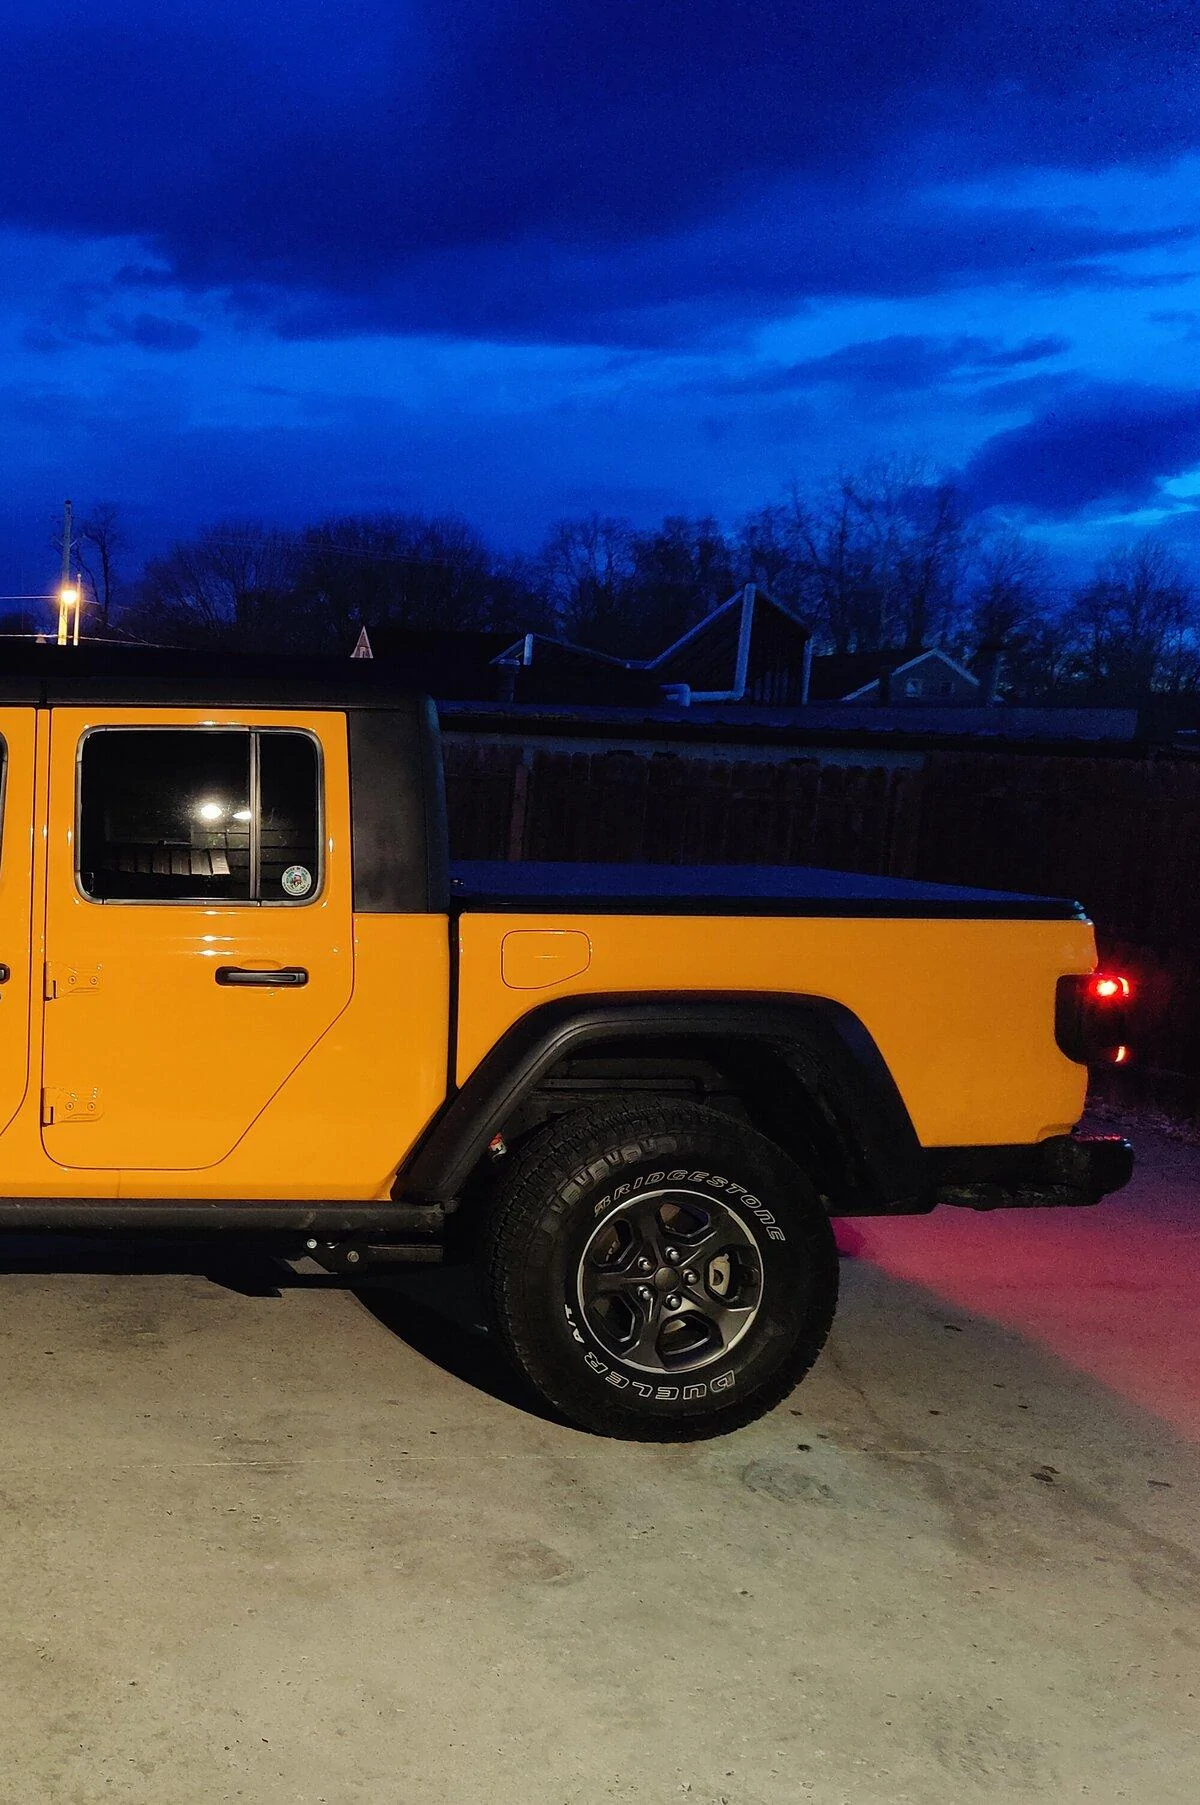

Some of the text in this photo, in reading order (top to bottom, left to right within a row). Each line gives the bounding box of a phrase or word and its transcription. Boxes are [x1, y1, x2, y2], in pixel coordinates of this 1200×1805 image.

[594, 1169, 786, 1242] BRIDGESTONE
[564, 1304, 736, 1400] DUELER A/T
